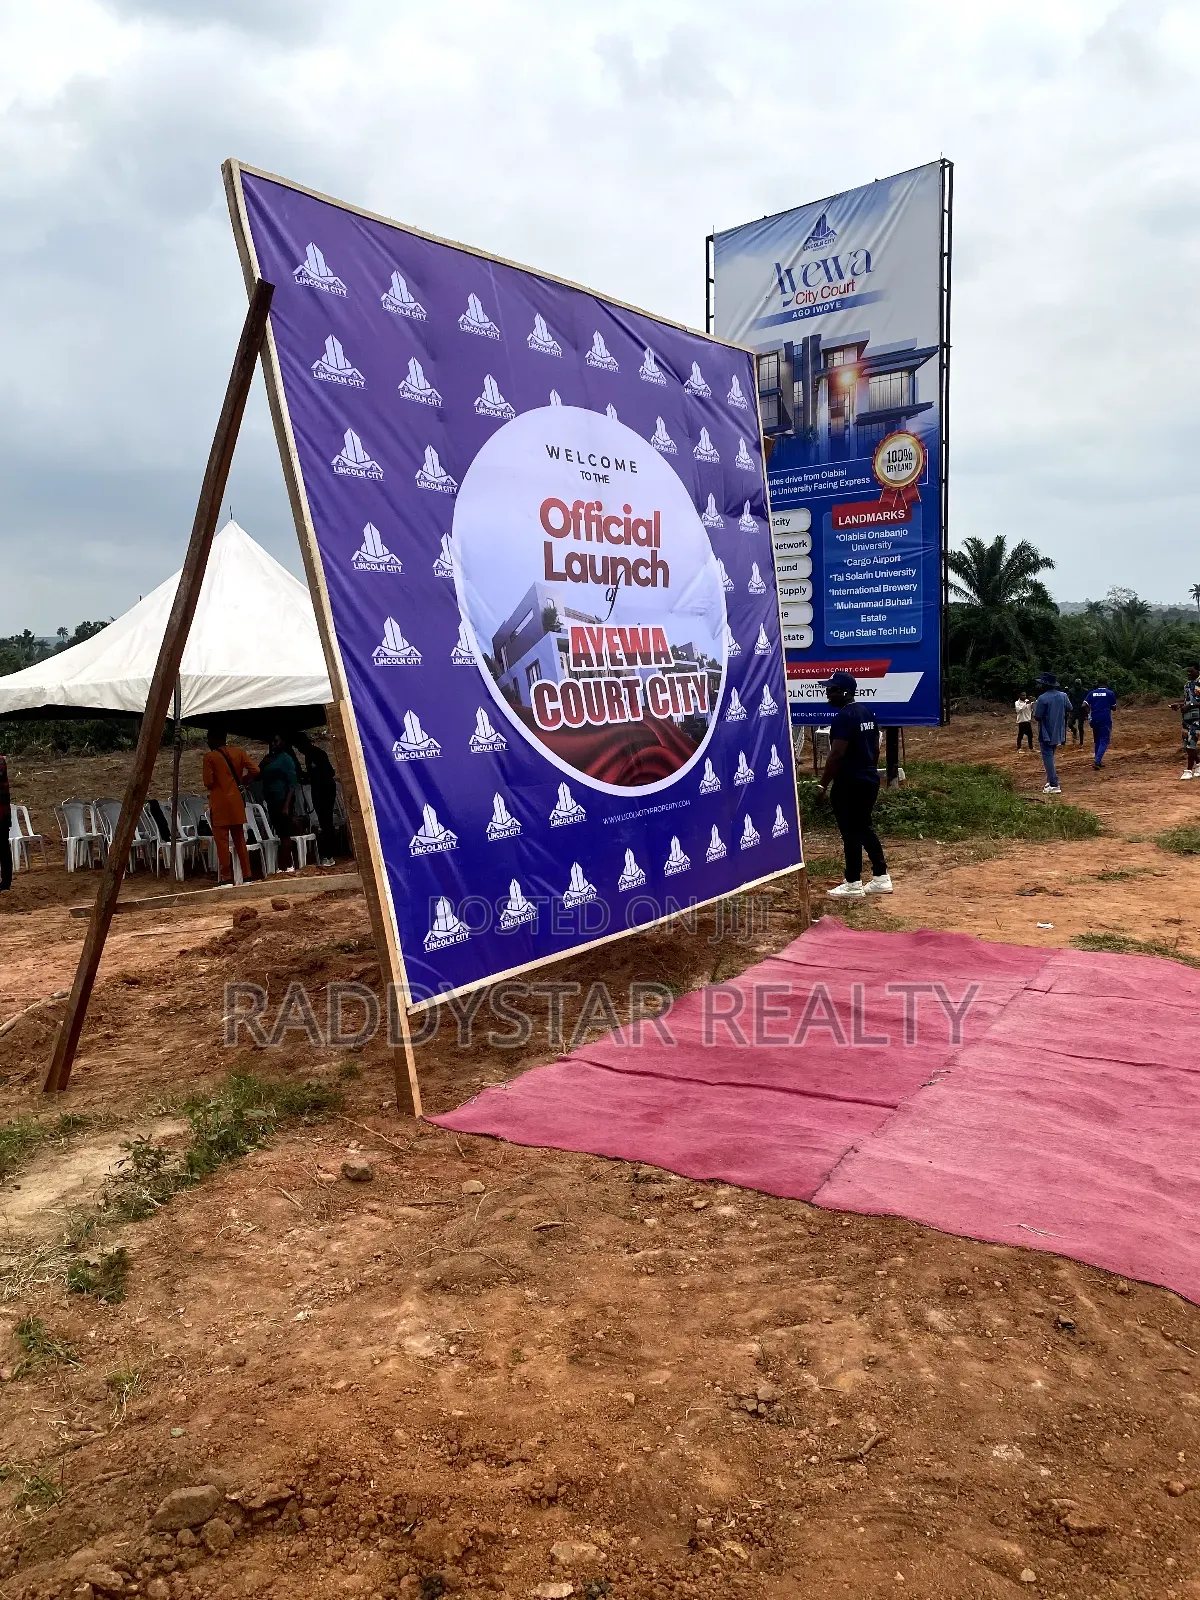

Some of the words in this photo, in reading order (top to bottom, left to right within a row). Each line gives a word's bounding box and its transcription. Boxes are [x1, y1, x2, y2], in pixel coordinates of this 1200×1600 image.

[803, 240, 824, 251] LINCOLN
[295, 276, 330, 292] LINCOLN
[332, 286, 346, 296] CITY
[796, 290, 818, 304] City
[820, 279, 856, 299] Court
[383, 302, 411, 316] LINCOLN
[412, 310, 426, 320] CITY
[792, 309, 810, 318] AGO
[813, 301, 842, 314] IWOYE
[460, 322, 486, 336] LINCOLN
[487, 330, 500, 340] CITY
[314, 371, 346, 384] LINCOLN
[349, 378, 364, 388] CITY
[400, 390, 428, 404] LINCOLN
[428, 398, 442, 406] CITY
[475, 407, 502, 416] LINCOLN
[504, 411, 516, 419] CITY
[545, 444, 638, 474] WELCOME
[886, 448, 912, 463] 100%
[334, 466, 366, 478] LINCOLN
[367, 470, 384, 480] CITY
[580, 470, 592, 480] TO
[593, 472, 610, 484] THE
[769, 478, 784, 486] utes
[785, 476, 802, 484] drive
[804, 474, 820, 482] from
[821, 468, 846, 479] Olabisi
[417, 480, 444, 491] LINCOLN
[444, 485, 458, 494] CITY
[778, 483, 812, 494] University
[814, 480, 838, 490] Facing
[840, 478, 870, 488] Express
[540, 498, 661, 548] Official
[773, 518, 790, 526] icity
[838, 510, 905, 526] LANDMARKS
[868, 528, 908, 538] Onabanjo
[852, 540, 892, 552] University
[544, 541, 670, 588] Launch
[872, 554, 902, 564] Airport
[354, 562, 385, 571] LINCOLN
[386, 564, 402, 572] CITY
[776, 563, 798, 572] ound
[846, 570, 874, 580] Solarin
[874, 568, 916, 578] University
[779, 586, 807, 596] Supply
[882, 582, 918, 593] Brewery
[885, 596, 913, 606] Buhari
[861, 614, 886, 622] Estate
[856, 628, 876, 637] State
[878, 627, 898, 636] Tech
[899, 626, 916, 635] Hub
[570, 626, 673, 669] AYEWA
[854, 688, 878, 696] ERTY
[532, 678, 643, 730] COURT
[648, 673, 708, 714] CITY
[394, 750, 426, 760] LINCOLN
[426, 748, 440, 758] CITY
[470, 744, 494, 752] LINCOLN
[494, 742, 506, 751] CITY
[550, 816, 574, 826] LINCOLN
[574, 814, 586, 822] CITY
[488, 830, 510, 840] LINCOLN
[510, 827, 520, 836] CITY
[412, 844, 443, 856] LINCOLN
[444, 840, 456, 850] CITY
[585, 894, 595, 902] CITY
[501, 916, 524, 928] LINCOLN
[525, 914, 536, 922] CITY
[425, 938, 454, 951] LINCOLN
[456, 932, 469, 940] CITY
